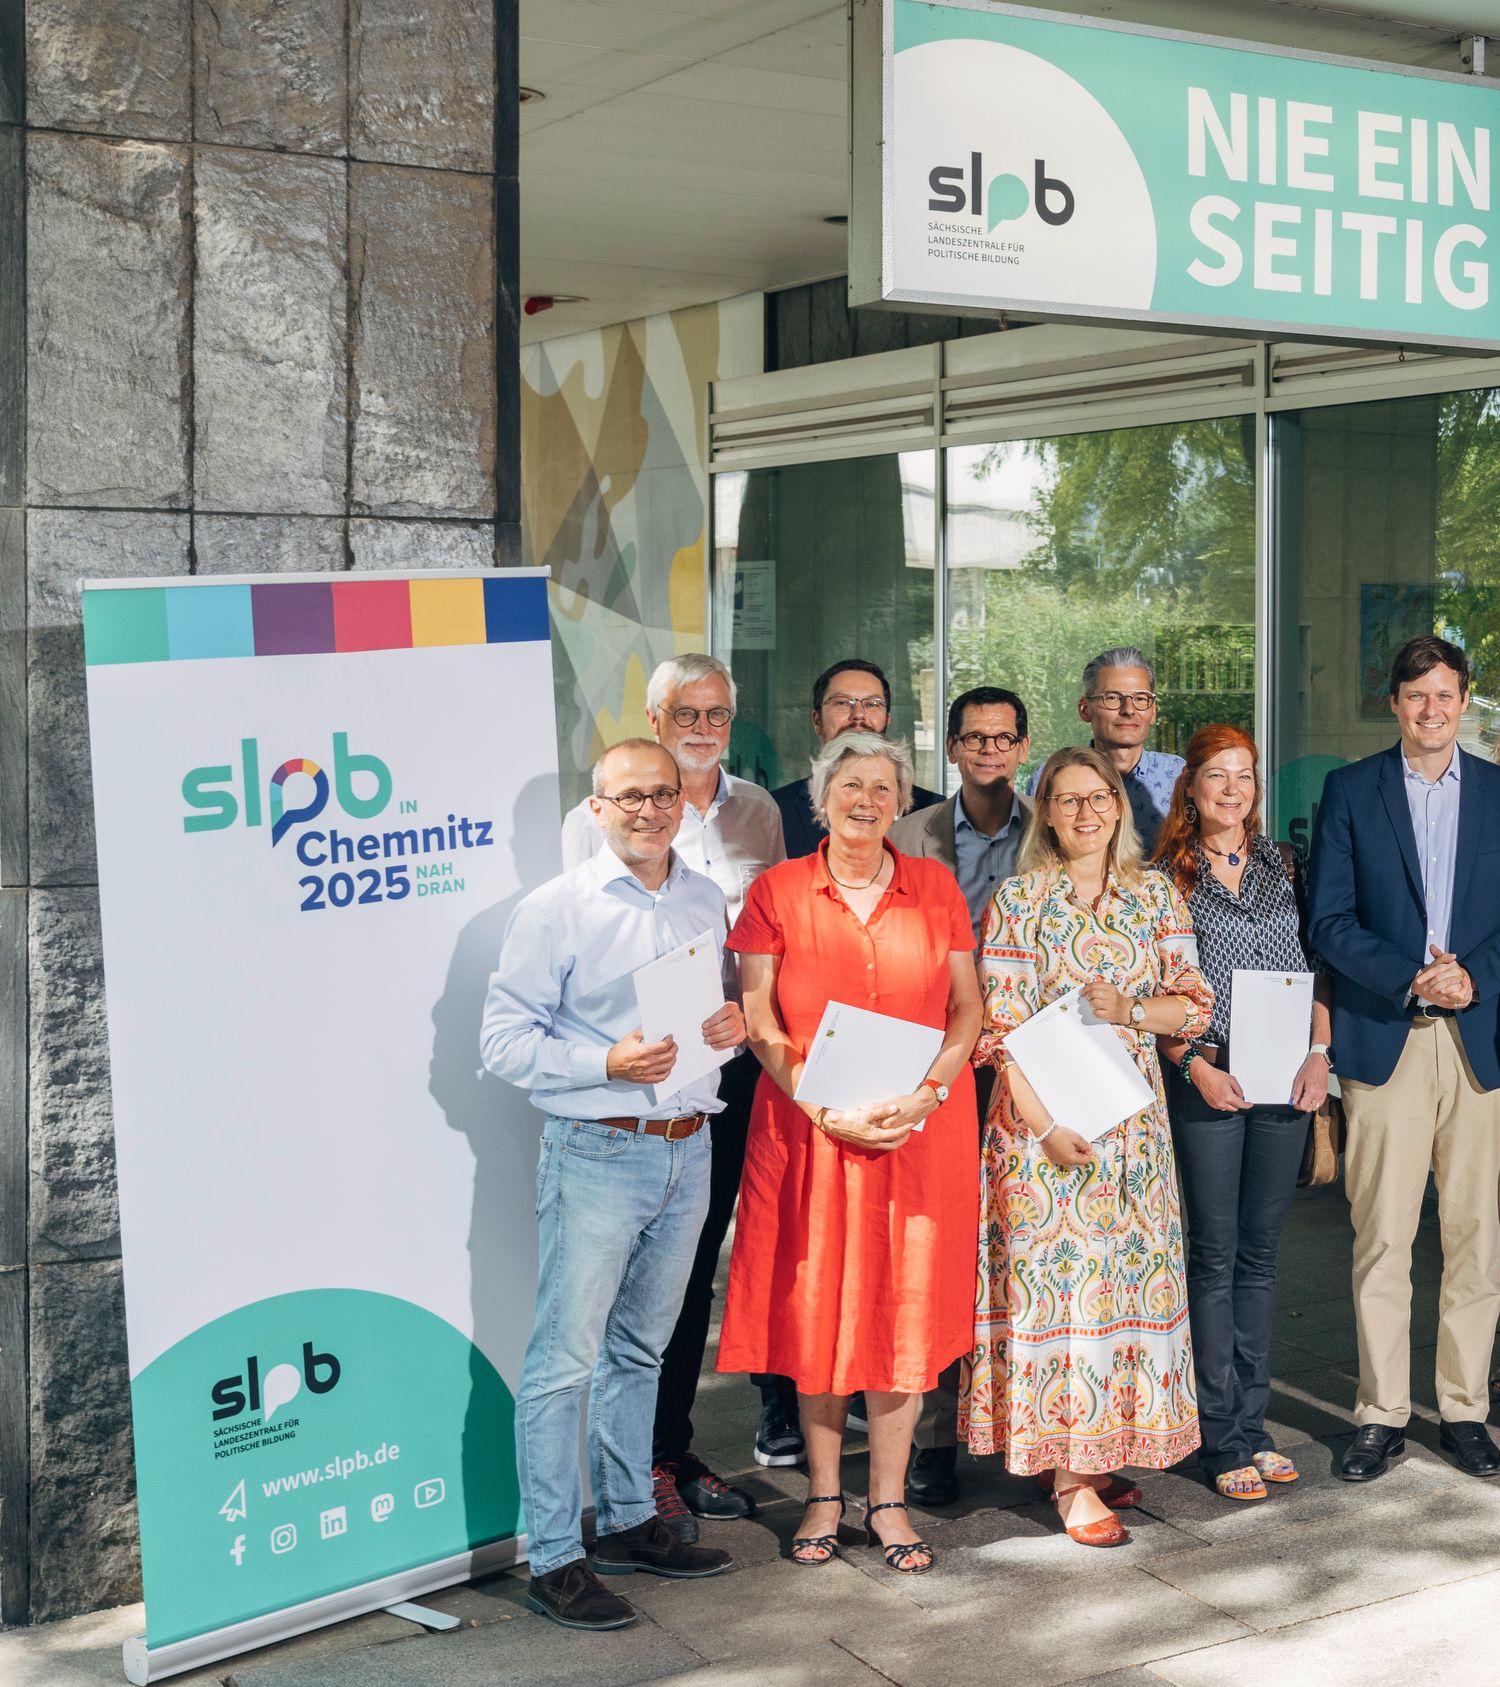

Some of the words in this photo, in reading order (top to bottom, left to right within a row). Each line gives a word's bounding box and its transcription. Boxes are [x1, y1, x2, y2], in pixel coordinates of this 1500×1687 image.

[1187, 86, 1335, 194] NIE
[1357, 110, 1491, 211] EIN
[928, 151, 1075, 234] slpb
[928, 221, 983, 236] SÄCHSISCHE
[928, 236, 1006, 251] LANDESZENTRALE
[1007, 242, 1025, 253] FÜR
[1186, 194, 1490, 311] SEITIG
[928, 248, 980, 262] POLITISCHE
[981, 253, 1020, 266] BILDUNG
[181, 731, 394, 848] slpb
[399, 799, 418, 814] IN
[296, 813, 494, 867] Chemnitz
[298, 864, 411, 912] 2025
[416, 862, 453, 879] NAH
[416, 877, 466, 897] DRAN
[211, 1341, 341, 1423] slpb
[213, 1418, 262, 1438] SÄCHSISCHE
[214, 1423, 283, 1449] LANDESZENTRALE
[284, 1418, 299, 1430] FÜR
[214, 1441, 261, 1460] POLITISCHE
[261, 1430, 296, 1447] BILDUNG
[262, 1442, 401, 1497] www.slpb.de
